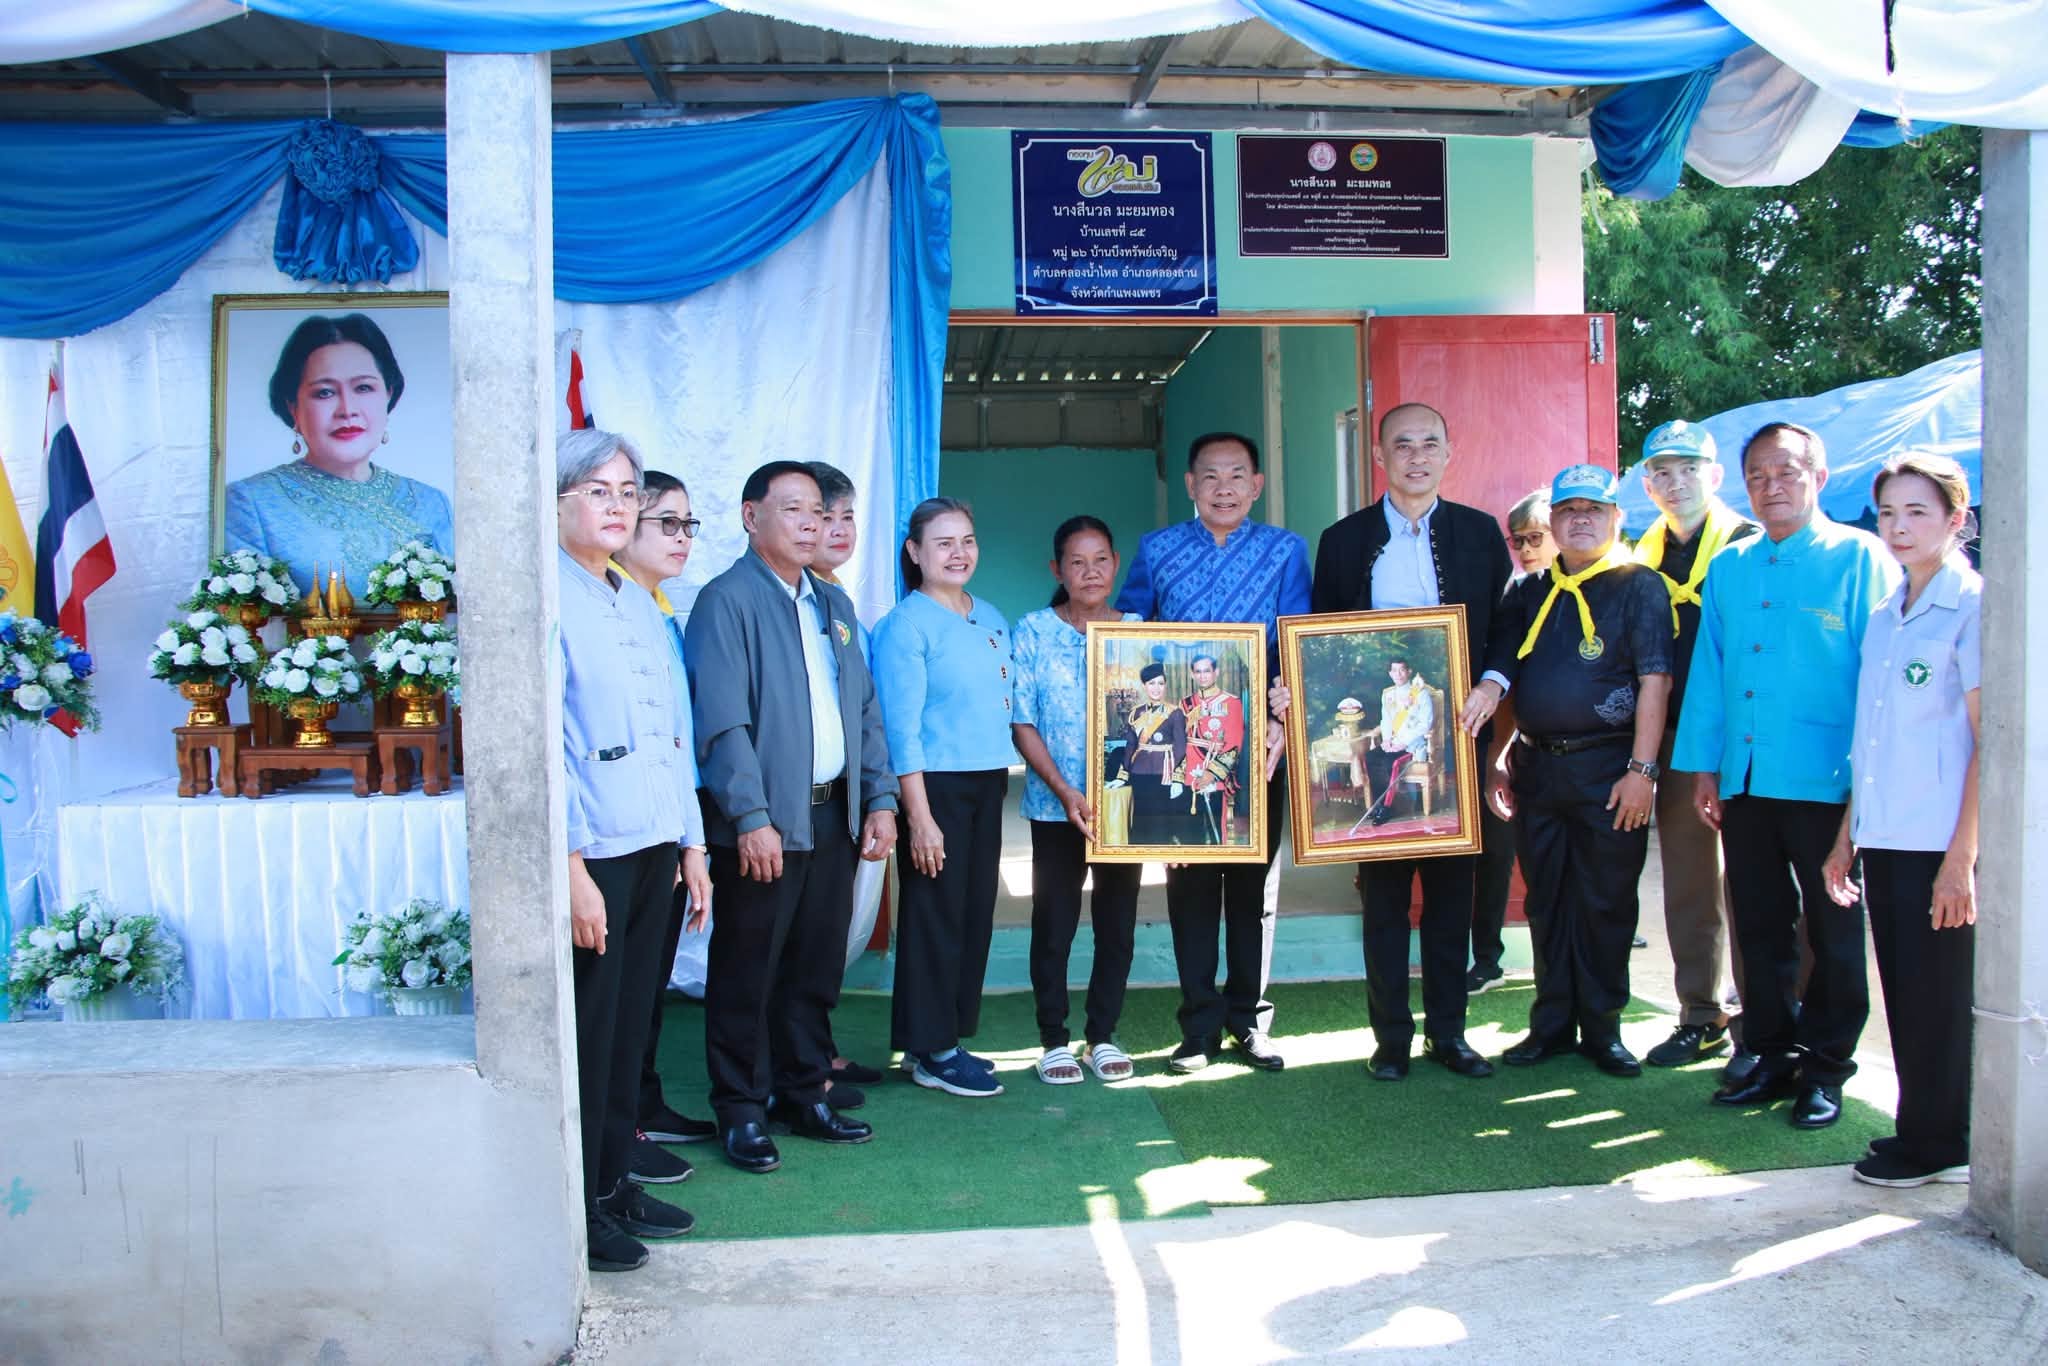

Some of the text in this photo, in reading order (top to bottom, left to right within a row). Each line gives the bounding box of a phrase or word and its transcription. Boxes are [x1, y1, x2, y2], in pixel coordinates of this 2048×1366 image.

[1290, 176, 1391, 188] นางสีนวล มะยมทอง
[1053, 202, 1174, 217] นางสีนวล มะยมทอง
[1080, 223, 1146, 237] บ้านเลขที่ ๘๕
[1052, 246, 1067, 261] หมู่
[1033, 263, 1197, 278] ตำบลคลองน้ำไหล อำเภอคลองลาน
[1071, 286, 1161, 298] จังหวัดกำแพงเพชร
